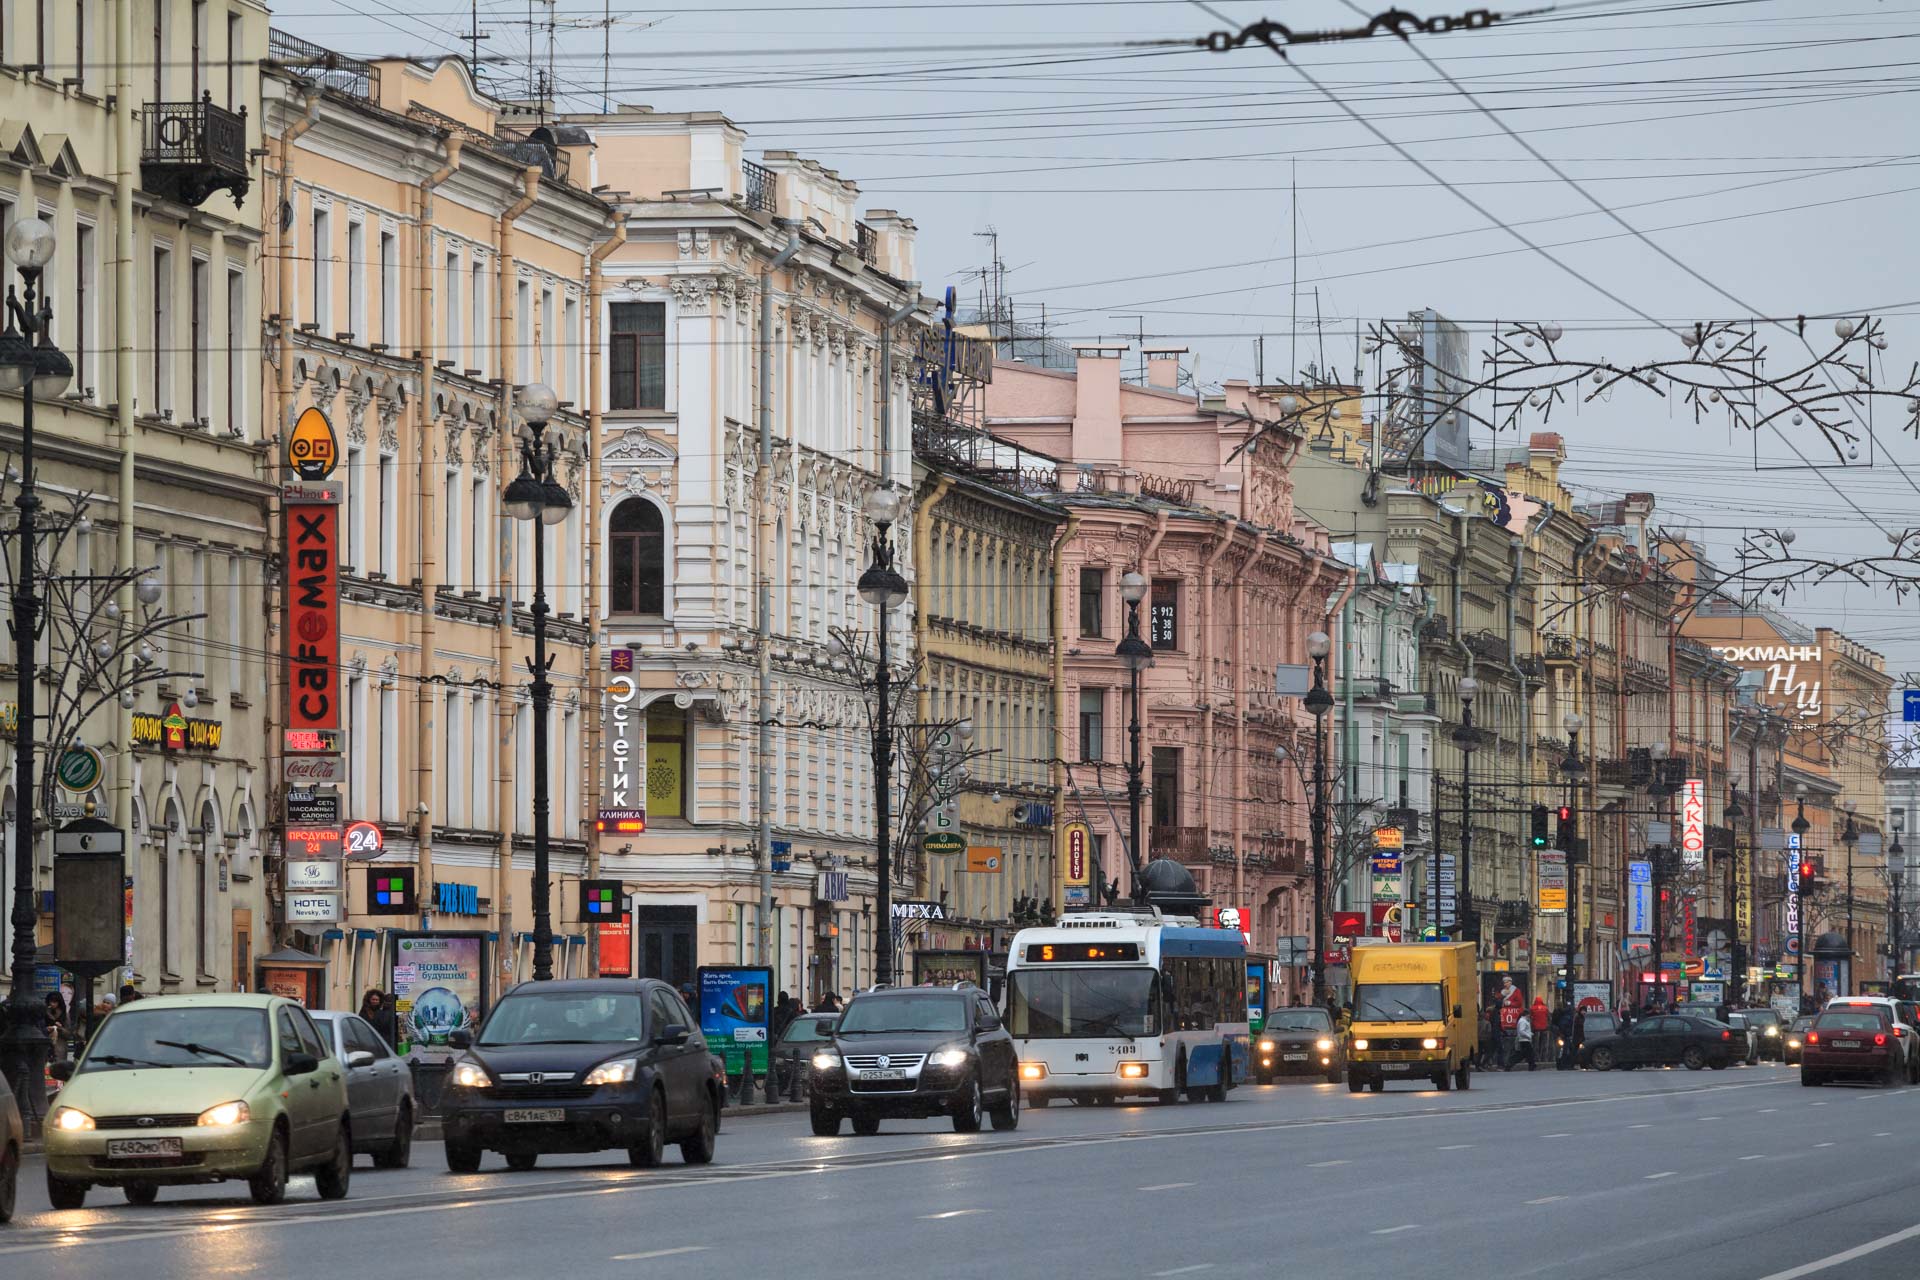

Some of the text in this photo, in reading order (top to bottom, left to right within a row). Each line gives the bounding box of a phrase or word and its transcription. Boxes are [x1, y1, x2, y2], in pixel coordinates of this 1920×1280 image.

[1161, 607, 1173, 616] 912
[1163, 631, 1171, 640] 50
[600, 811, 640, 819] КЛИНИКА
[349, 831, 377, 851] 24
[307, 843, 320, 853] 24
[1043, 946, 1053, 960] 5
[422, 972, 467, 981] будущим!
